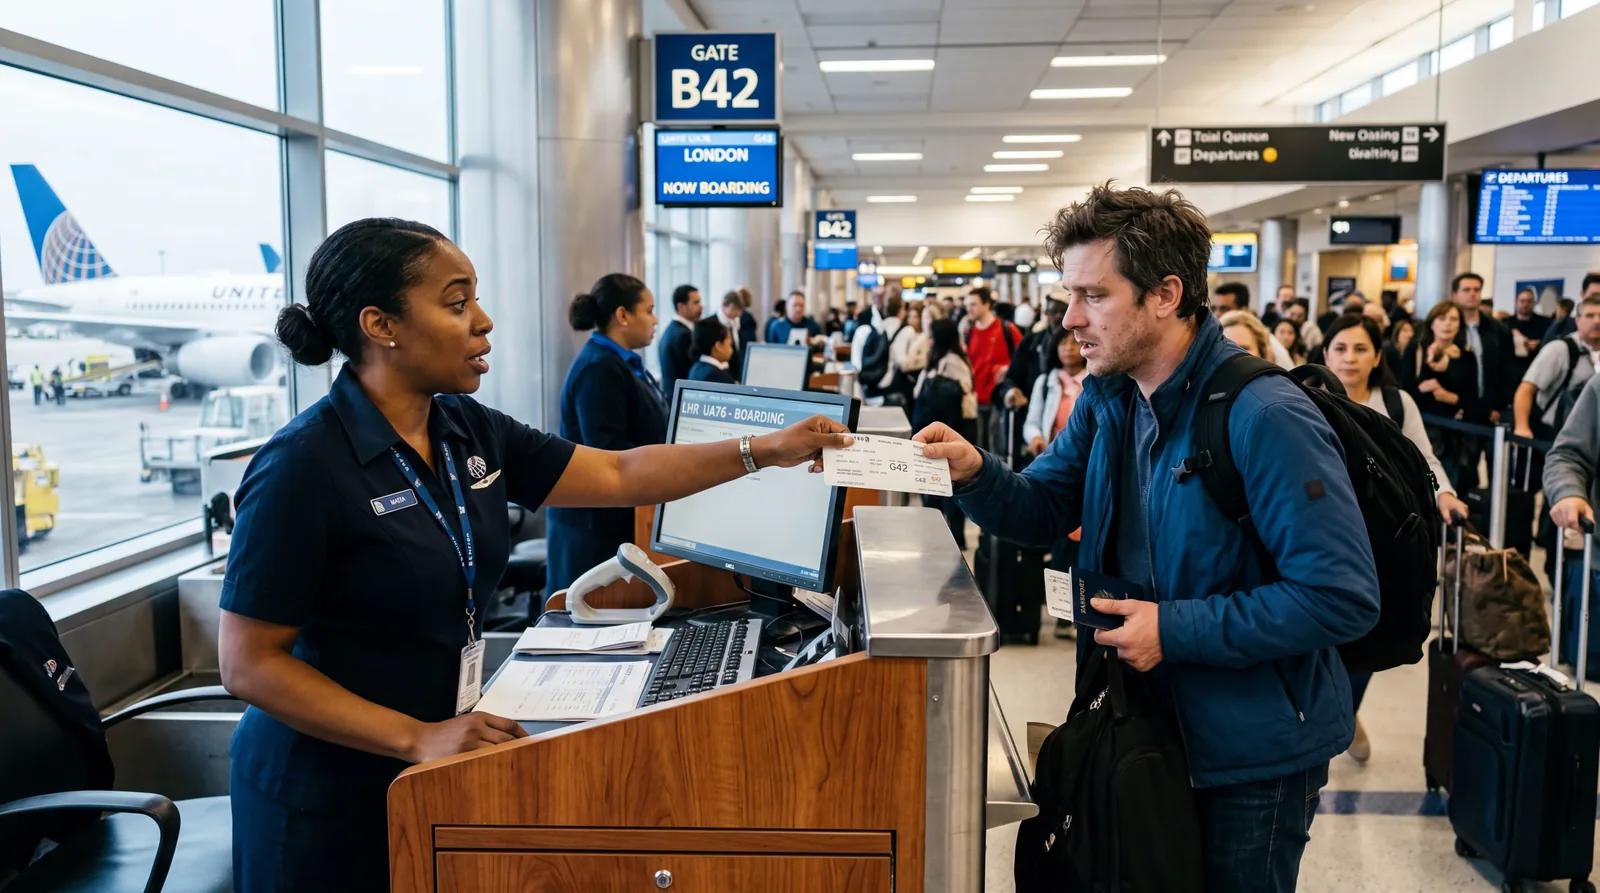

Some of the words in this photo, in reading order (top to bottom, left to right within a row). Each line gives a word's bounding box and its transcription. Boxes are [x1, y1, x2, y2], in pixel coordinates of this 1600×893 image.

[691, 44, 739, 61] GATE
[671, 68, 760, 109] B42
[684, 148, 749, 163] LONDON
[1193, 148, 1259, 163] Departures
[1498, 172, 1568, 184] DEPARTURES
[663, 181, 697, 194] NOW
[700, 181, 770, 194] BOARDING
[818, 220, 852, 238] B42
[682, 402, 699, 415] LHR
[703, 404, 727, 418] UA76
[734, 407, 785, 425] BOARDING
[889, 462, 908, 473] G42
